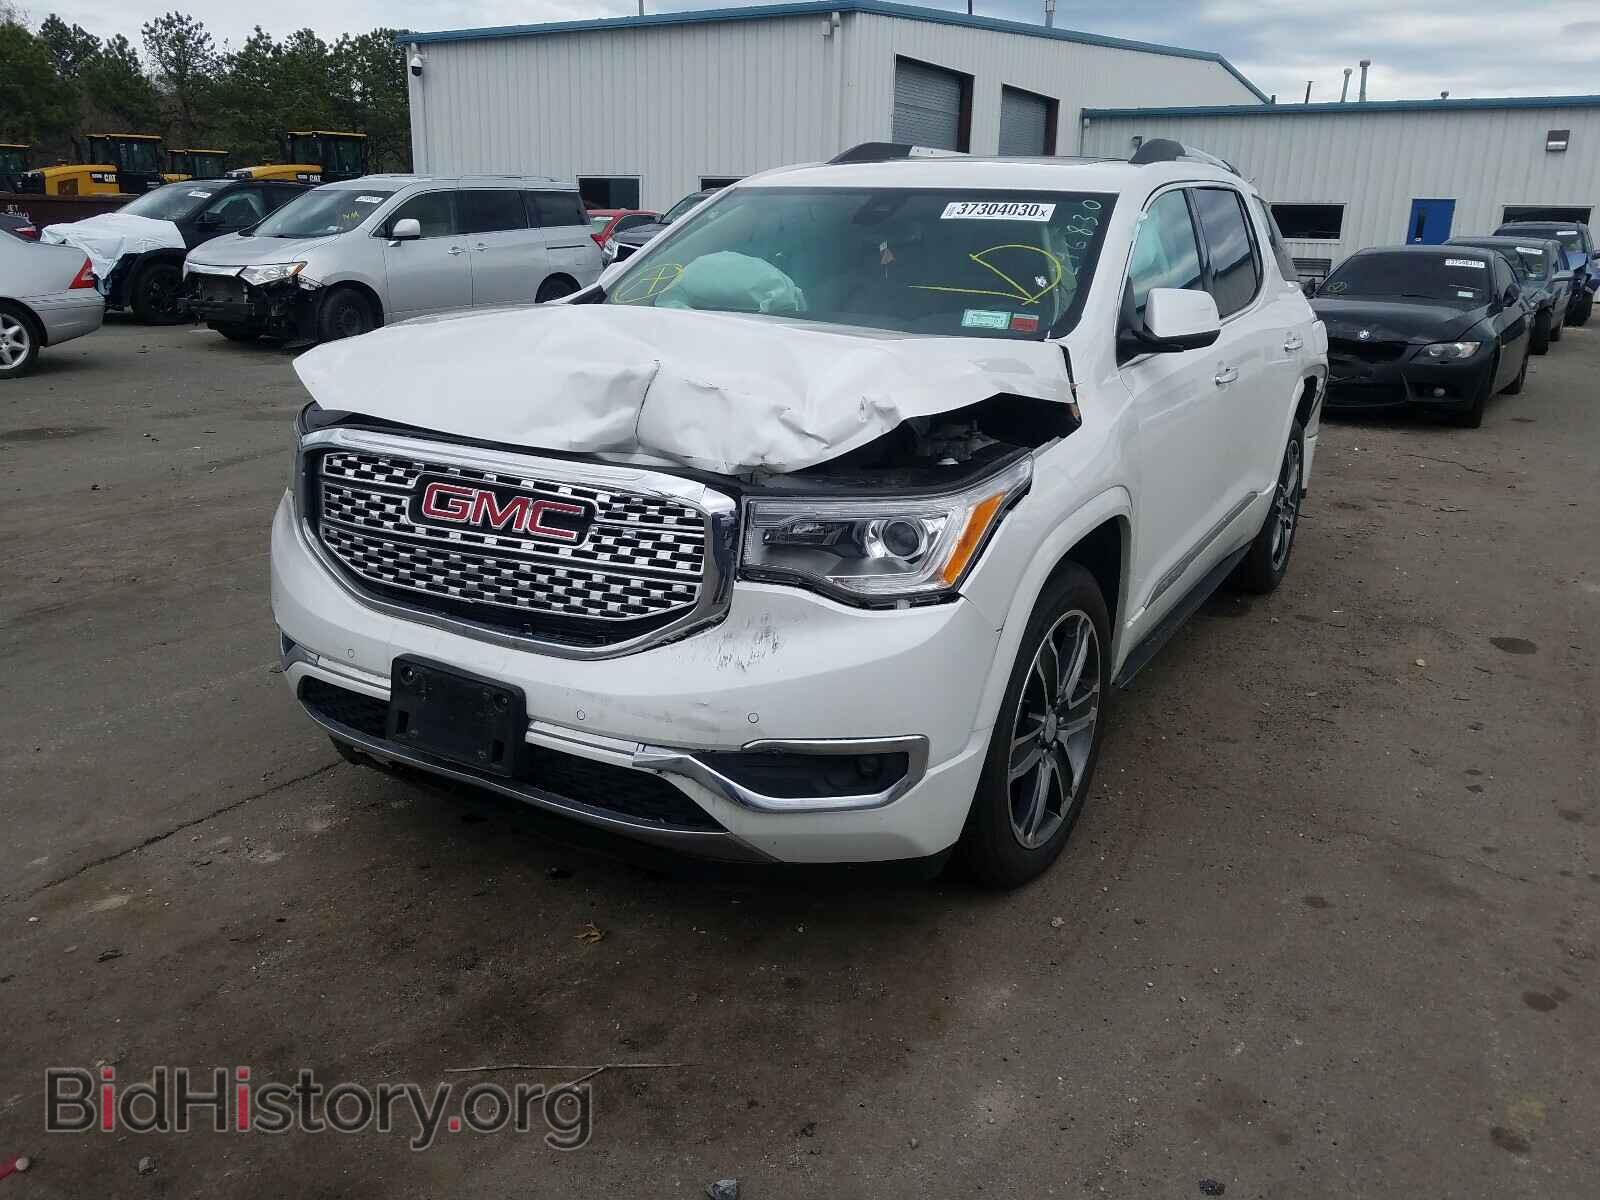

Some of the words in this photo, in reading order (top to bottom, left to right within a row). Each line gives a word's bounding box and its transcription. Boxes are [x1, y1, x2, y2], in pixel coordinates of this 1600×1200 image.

[104, 174, 117, 182] CAT
[310, 174, 321, 182] CAT
[422, 482, 585, 542] GMC
